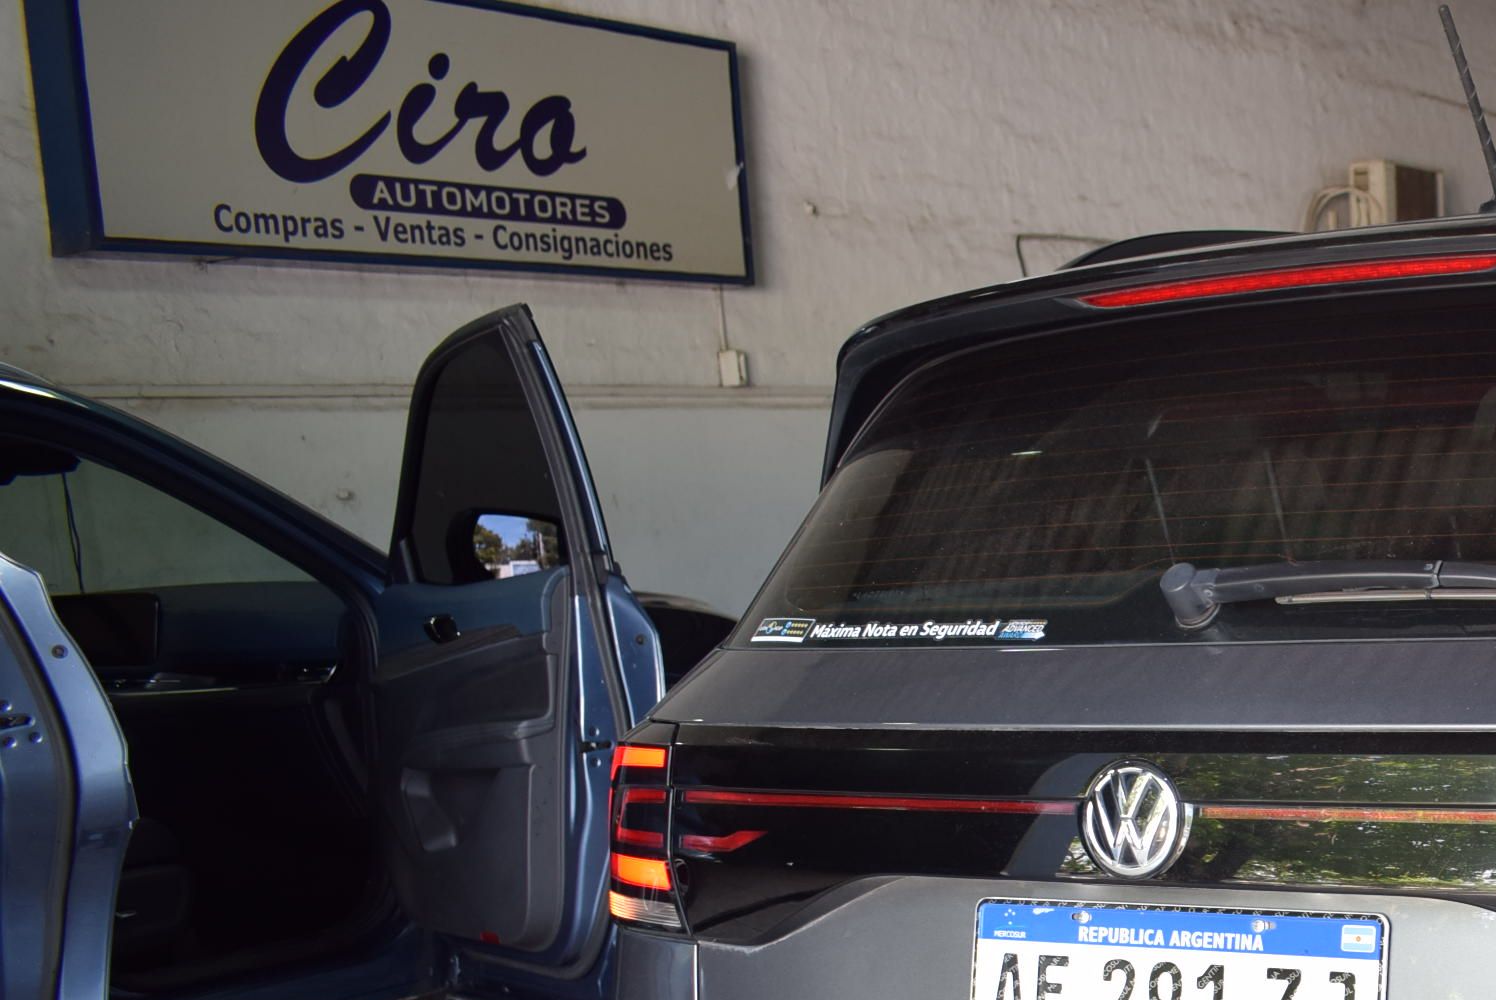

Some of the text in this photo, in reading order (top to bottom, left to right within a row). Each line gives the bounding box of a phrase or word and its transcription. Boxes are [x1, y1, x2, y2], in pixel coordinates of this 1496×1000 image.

[254, 0, 587, 184] Ciro
[372, 180, 611, 224] AUTOMOTORES
[213, 203, 345, 243] Compras
[373, 215, 466, 247] Ventas
[492, 224, 673, 262] Consignaciones
[810, 623, 861, 638] Máxima
[862, 623, 898, 637] Nota
[900, 625, 919, 636] en
[920, 621, 1001, 639] Seguridad
[993, 930, 1026, 939] MERCOSUR
[1078, 926, 1264, 952] REPUBLICA ARGENTINA
